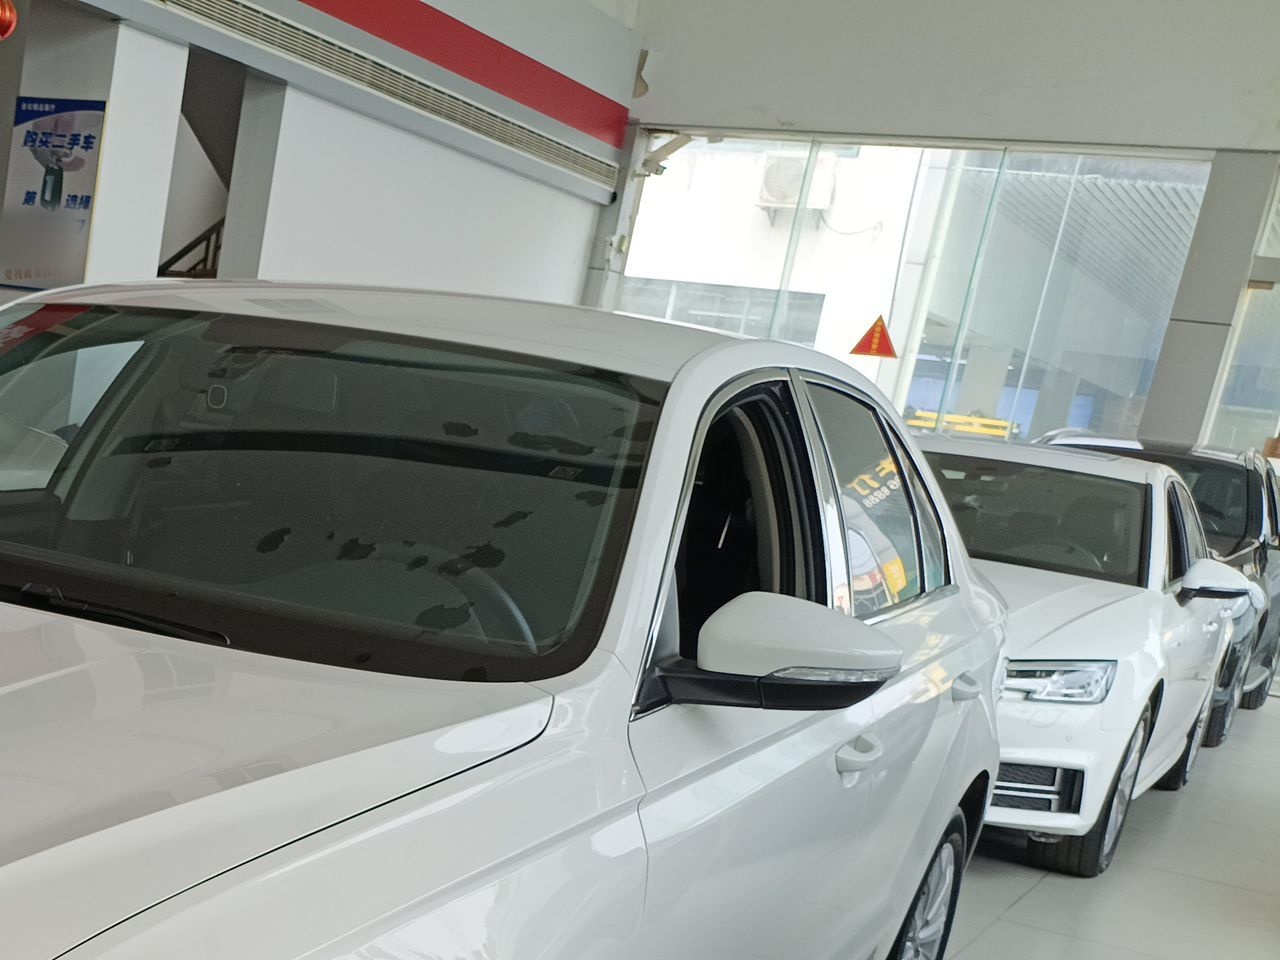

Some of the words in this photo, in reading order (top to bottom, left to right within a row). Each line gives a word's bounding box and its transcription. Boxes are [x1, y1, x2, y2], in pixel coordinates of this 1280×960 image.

[22, 130, 96, 152] 购买二手车
